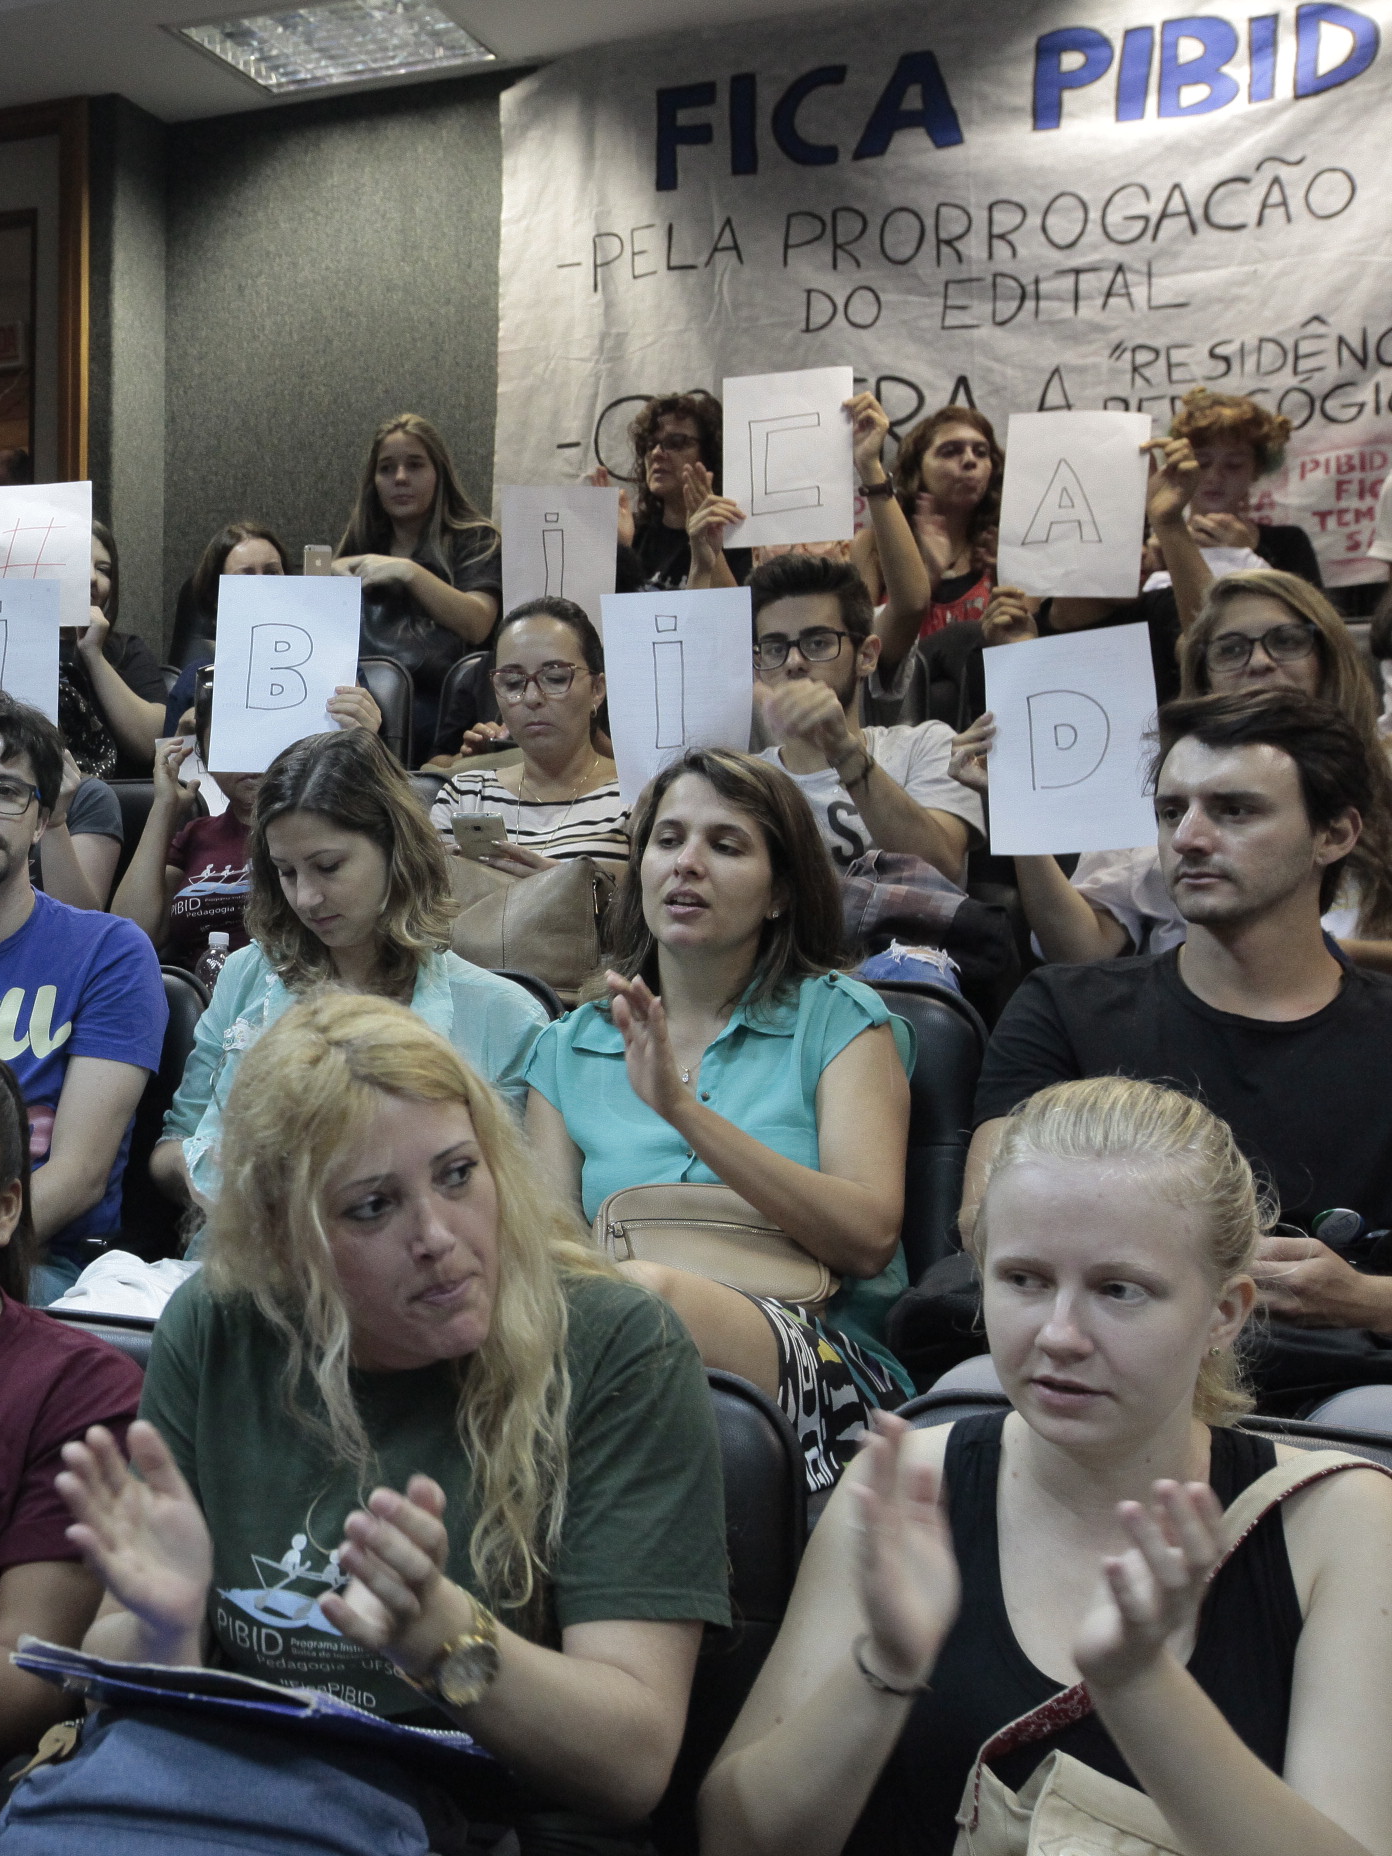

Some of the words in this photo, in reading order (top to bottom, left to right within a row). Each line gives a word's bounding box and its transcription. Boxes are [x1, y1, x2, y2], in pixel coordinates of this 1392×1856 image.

[655, 49, 964, 192] FICA
[1031, 2, 1380, 132] PIBID
[801, 285, 882, 333] DO
[941, 260, 1190, 331] EDITAL
[1299, 450, 1389, 481] PIBID
[1021, 458, 1103, 546] A
[245, 623, 314, 711] B
[1026, 690, 1111, 791] D
[186, 906, 236, 918] Pedagogia
[217, 1608, 284, 1656] PIBID
[290, 1637, 338, 1652] Programa
[257, 1653, 346, 1672] Pedagogia
